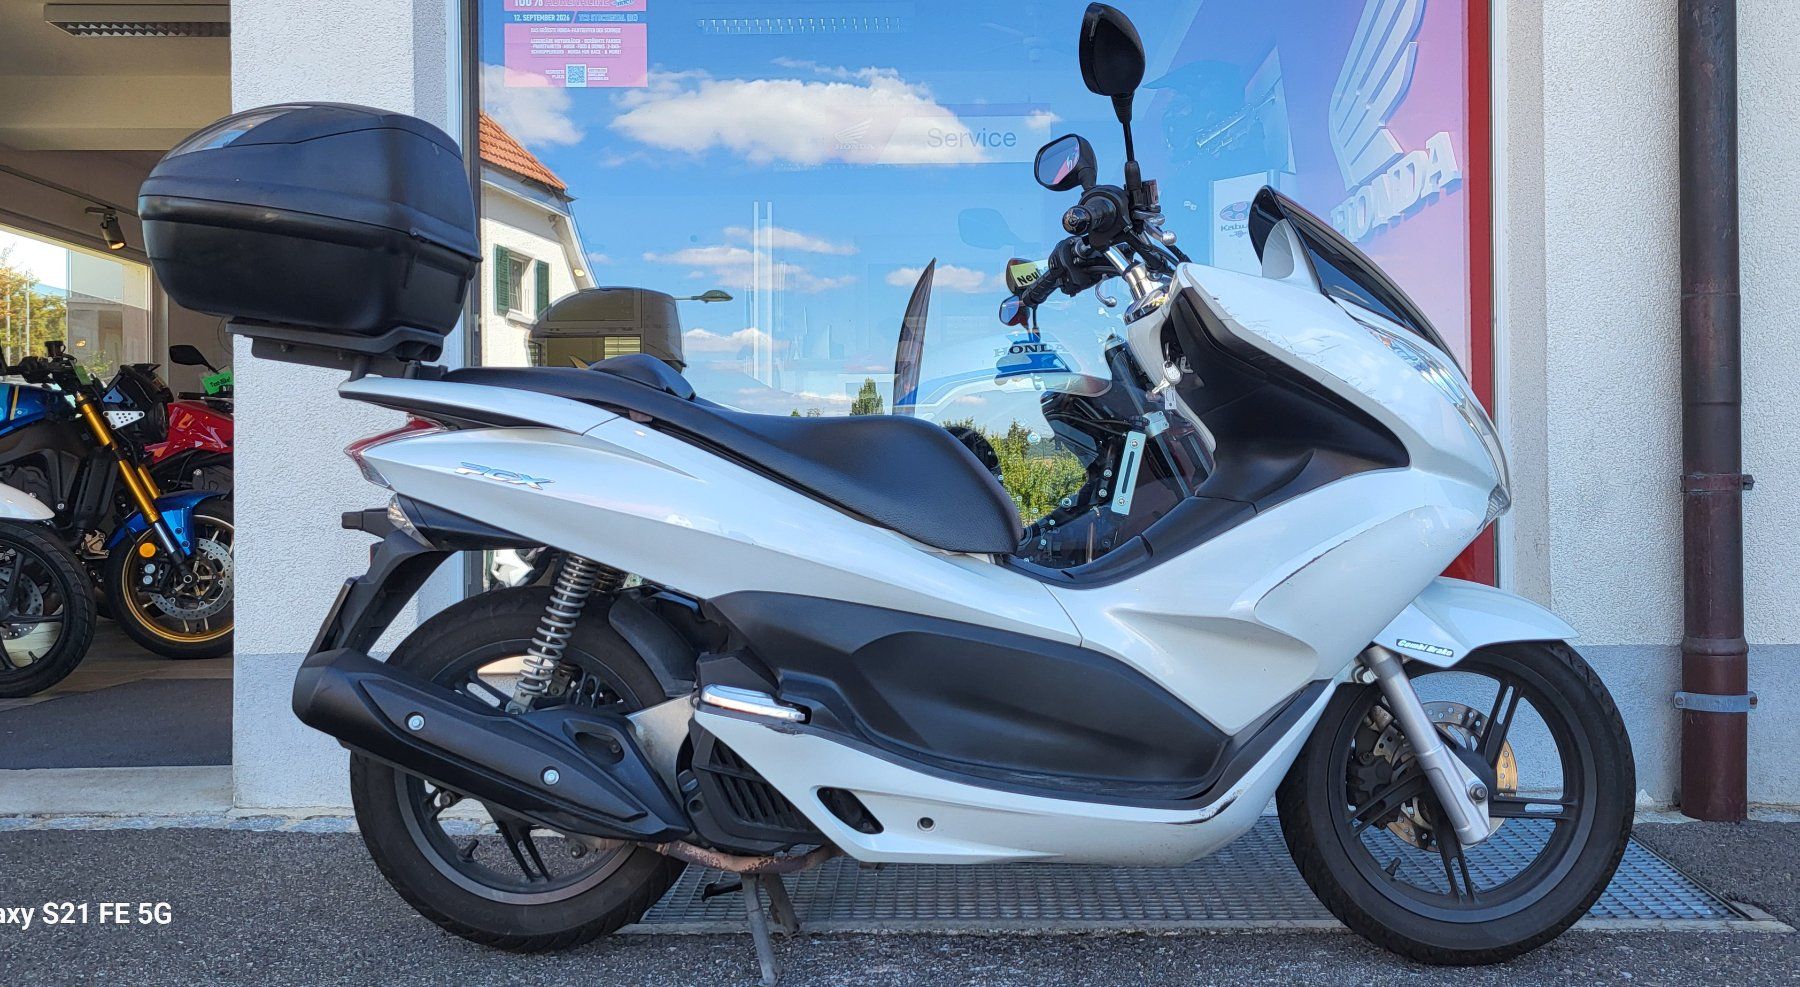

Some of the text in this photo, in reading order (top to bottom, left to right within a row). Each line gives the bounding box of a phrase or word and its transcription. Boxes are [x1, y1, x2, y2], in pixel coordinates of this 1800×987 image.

[927, 127, 1017, 148] Service
[1220, 222, 1247, 232] Kabu
[454, 461, 556, 490] PCX
[1398, 639, 1453, 657] Combi Brake
